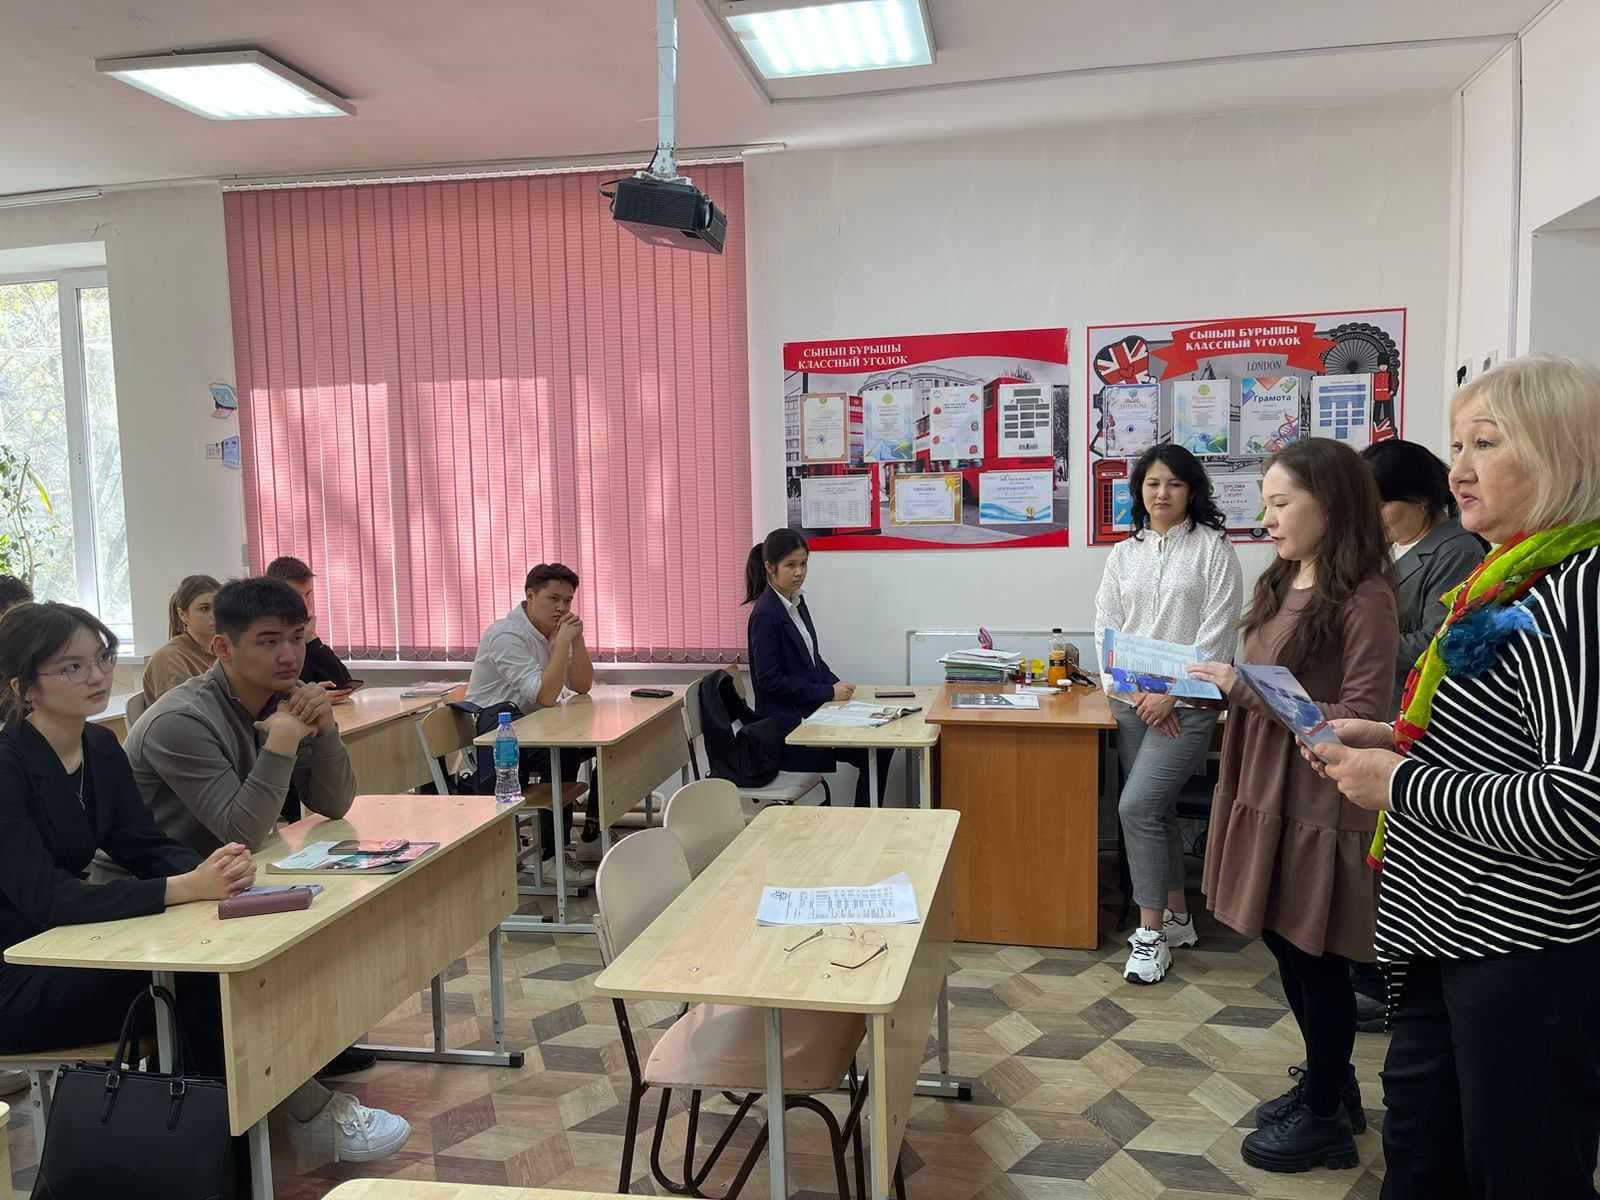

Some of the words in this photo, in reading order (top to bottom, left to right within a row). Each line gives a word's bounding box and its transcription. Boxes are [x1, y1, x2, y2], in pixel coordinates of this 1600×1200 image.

[1190, 329, 1235, 340] СЫНЫП
[1185, 338, 1250, 351] КЛАССНЫЙ
[1255, 337, 1301, 347] УГОЛОК
[803, 346, 847, 357] СЫНЫП
[798, 357, 860, 369] КЛАССНЫЙ
[862, 355, 908, 366] УГОЛОК
[1247, 360, 1281, 371] LONDON
[1253, 394, 1291, 402] Грамота
